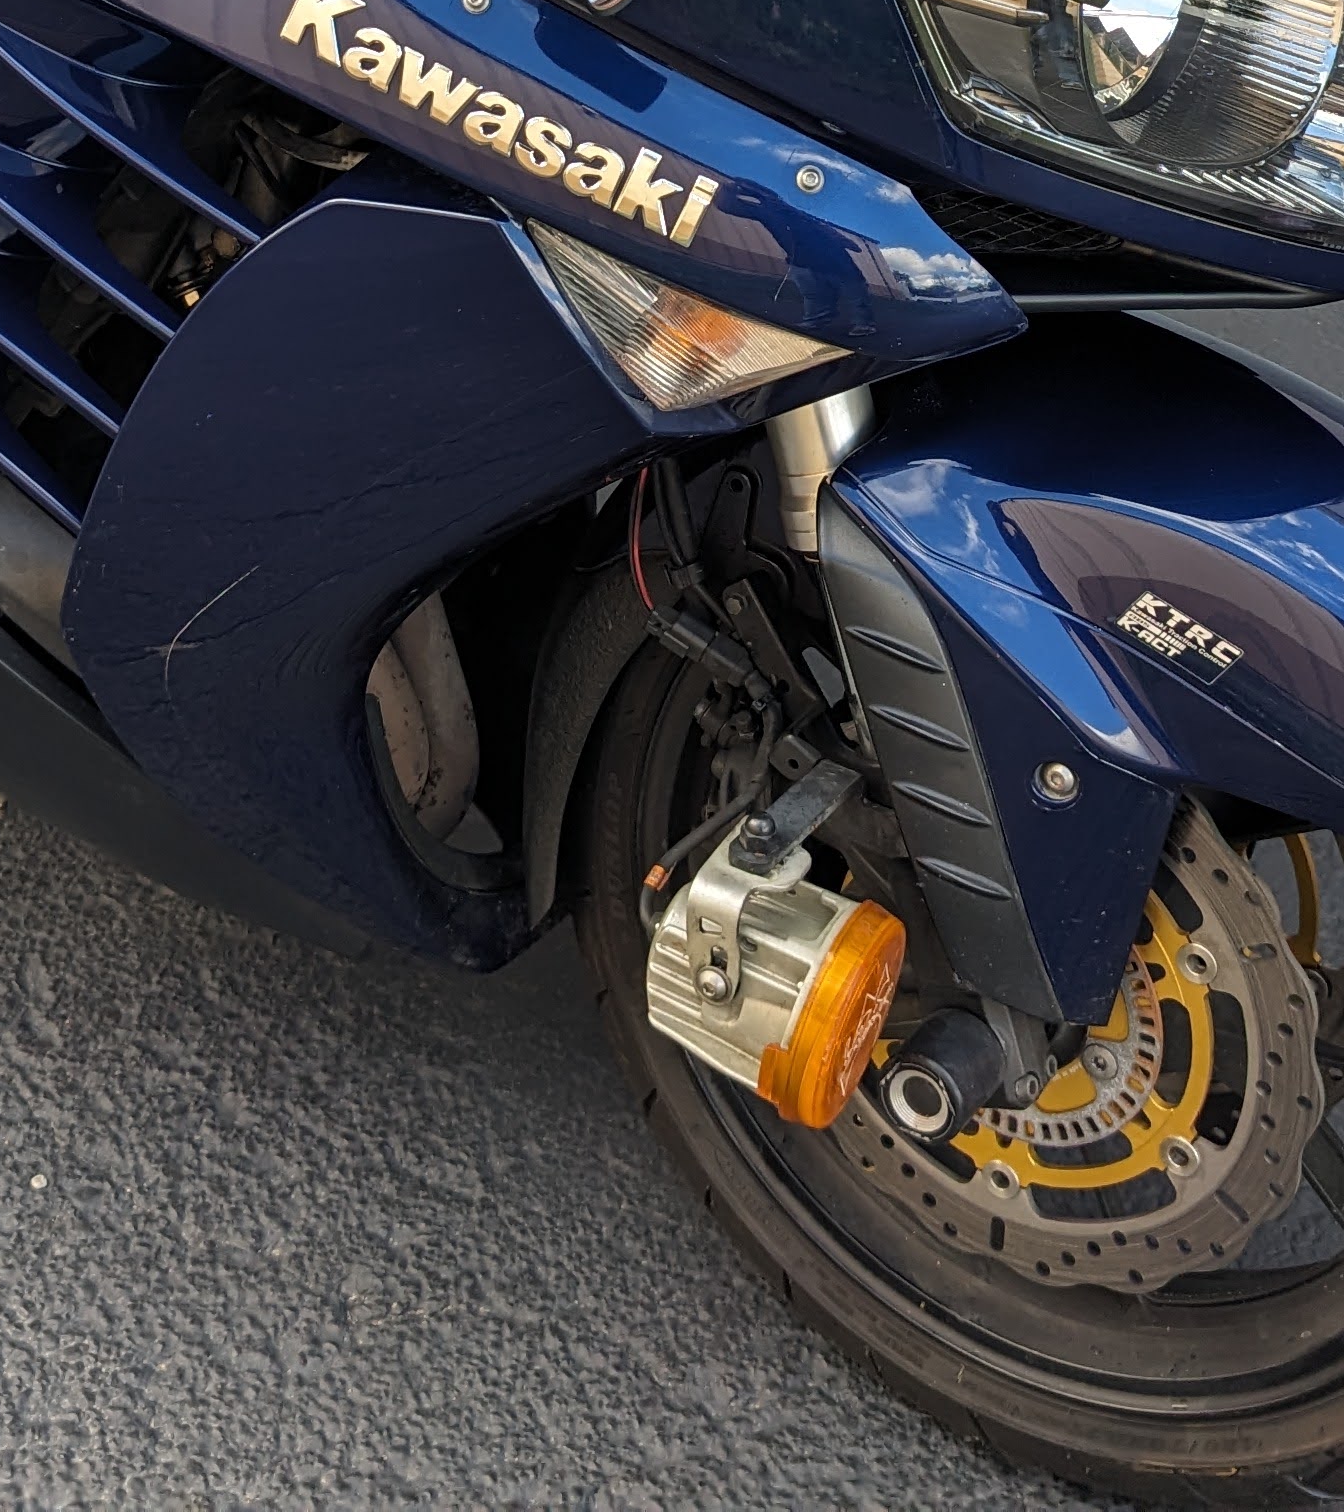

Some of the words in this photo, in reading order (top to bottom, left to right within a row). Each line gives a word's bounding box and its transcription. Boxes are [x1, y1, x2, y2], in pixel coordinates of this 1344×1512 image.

[1116, 614, 1183, 658] K-ACT
[1130, 605, 1167, 631] Kawasaki
[1168, 627, 1198, 651] Traction
[1198, 645, 1228, 669] Control
[1135, 592, 1241, 664] KTRC
